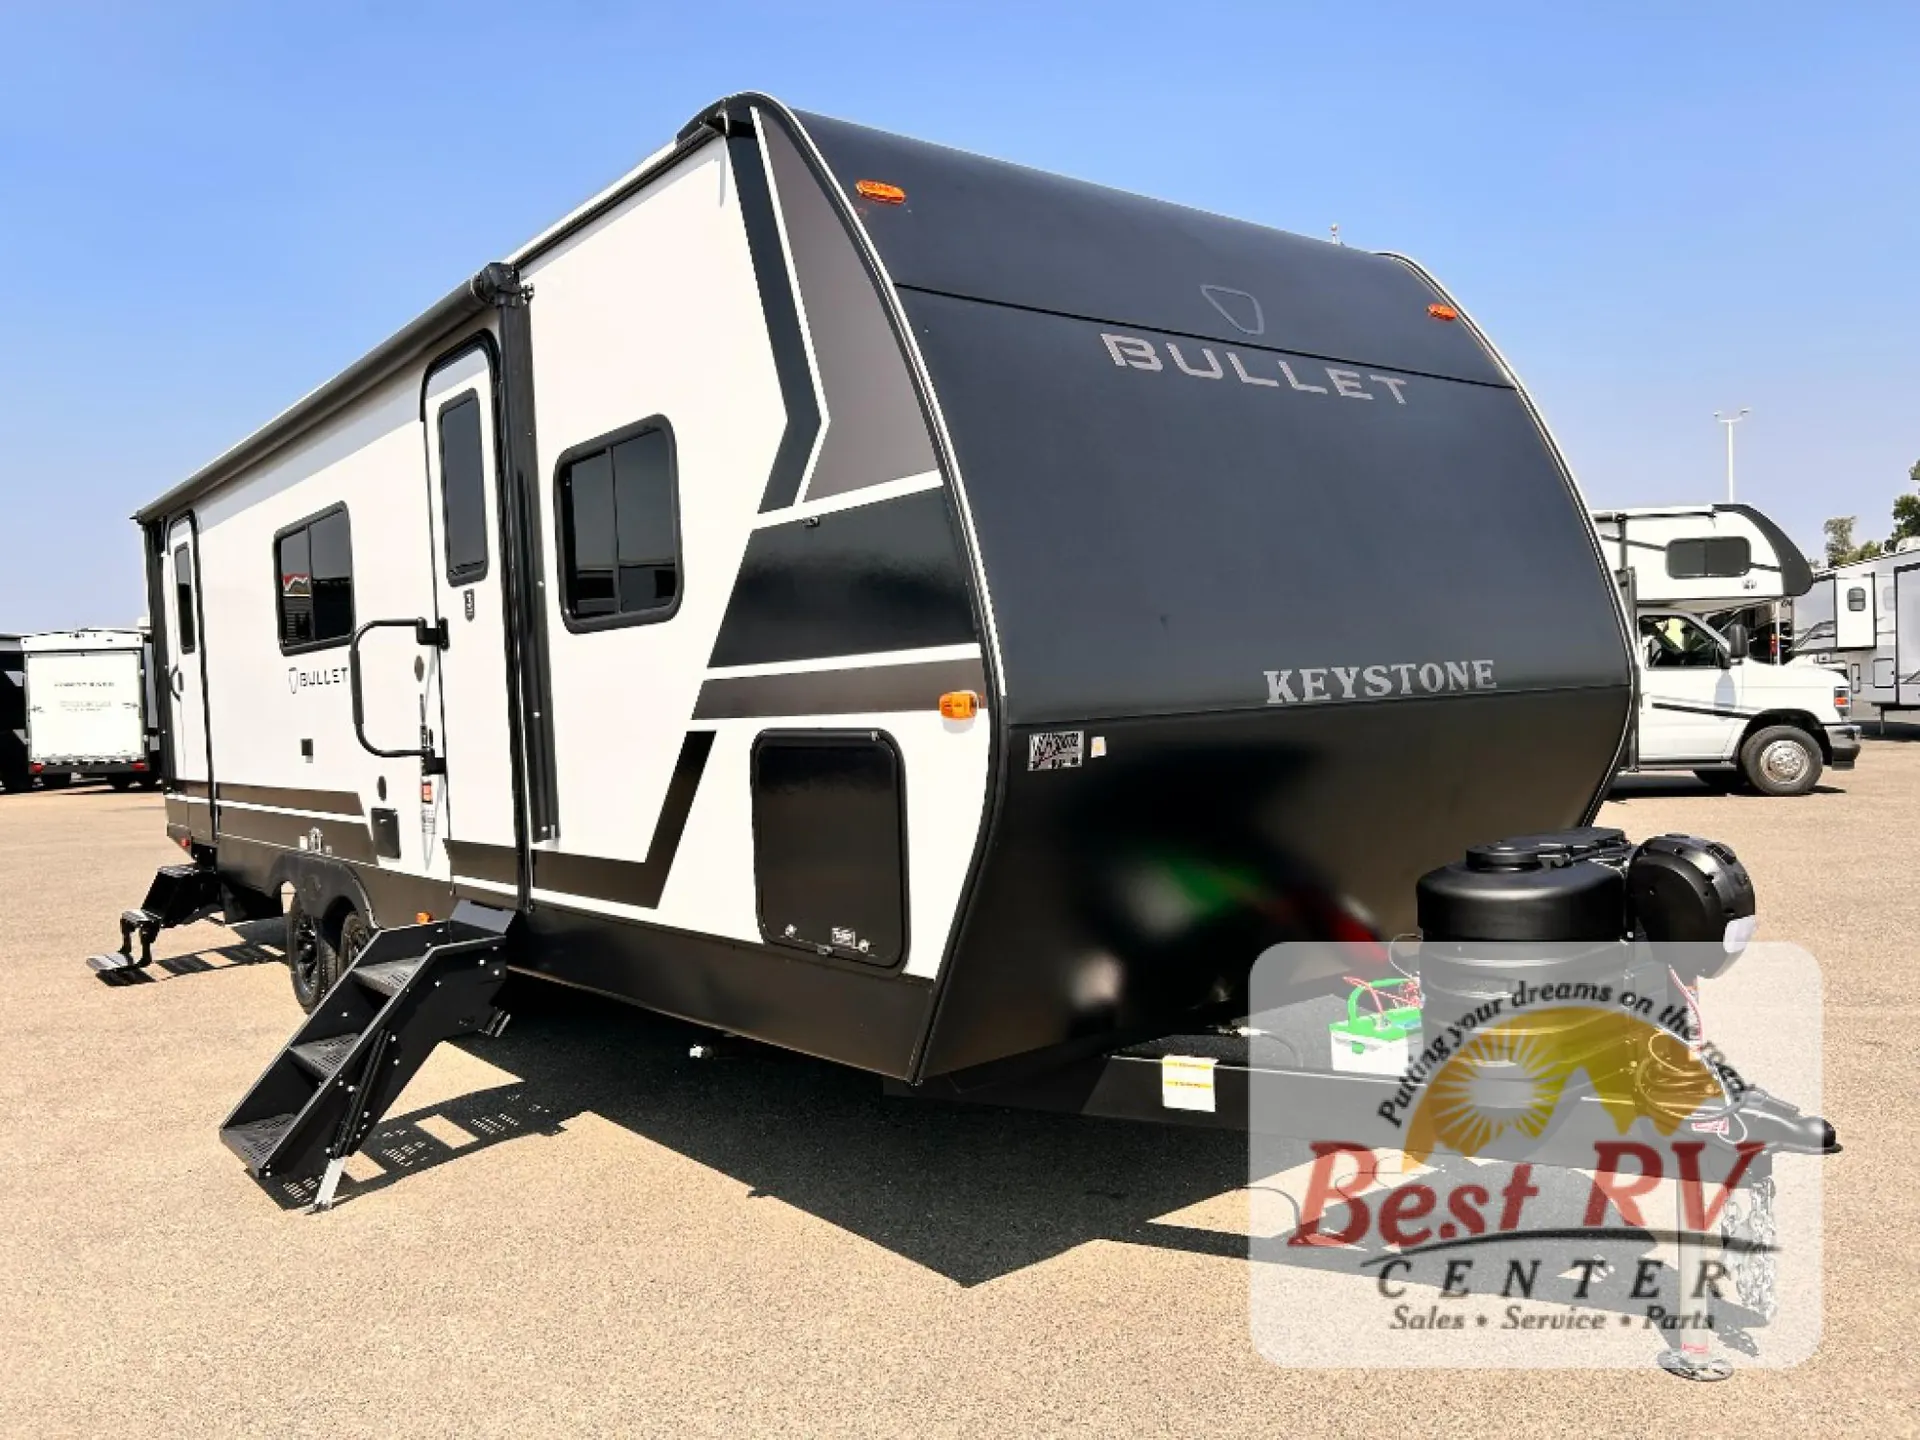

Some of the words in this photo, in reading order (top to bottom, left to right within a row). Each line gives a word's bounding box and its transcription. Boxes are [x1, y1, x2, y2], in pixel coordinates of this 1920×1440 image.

[1101, 333, 1406, 404] BULLET
[300, 667, 348, 687] BULLET
[1263, 659, 1497, 704] KEYSTONE
